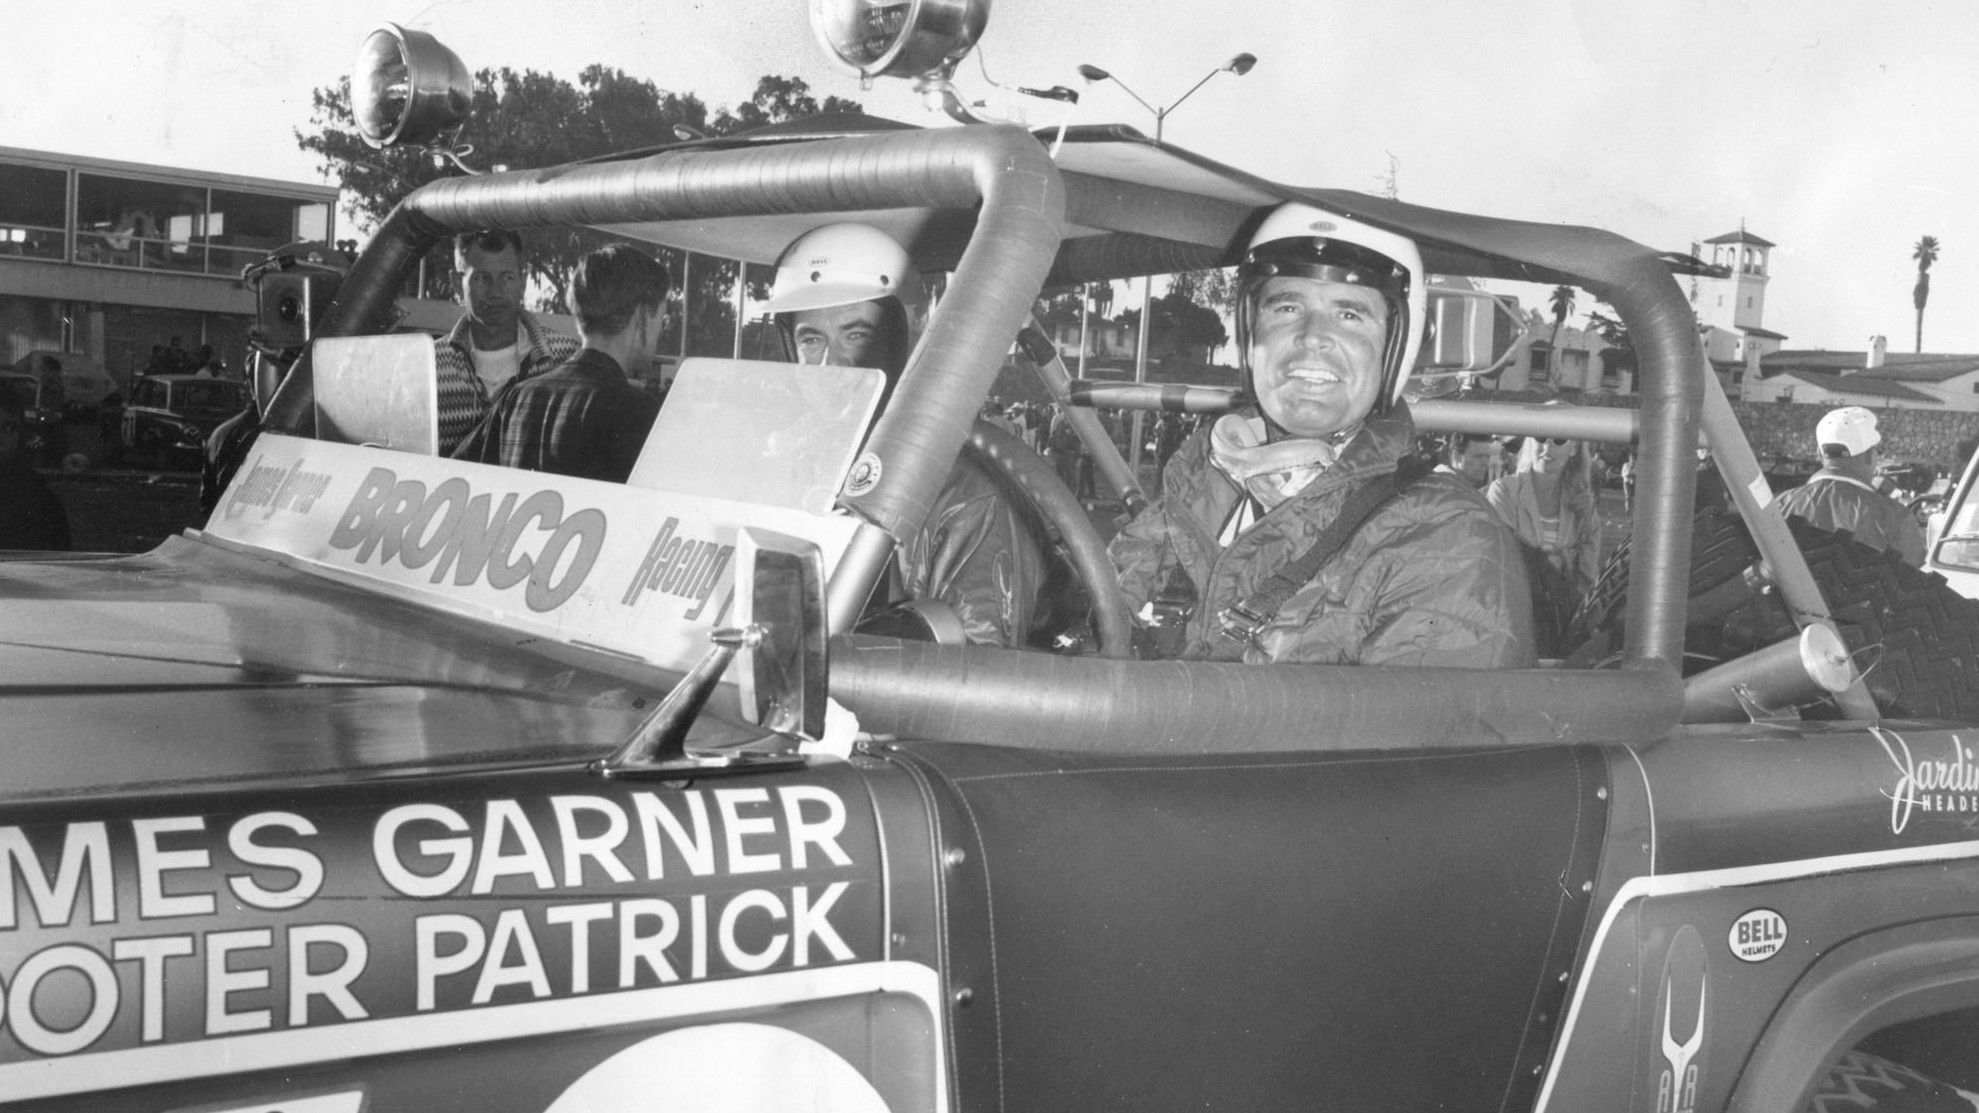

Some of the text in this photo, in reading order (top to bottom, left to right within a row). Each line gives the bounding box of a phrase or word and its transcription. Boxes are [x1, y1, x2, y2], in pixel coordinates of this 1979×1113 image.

[328, 466, 607, 613] BRONCO
[621, 516, 736, 621] Racing
[0, 785, 853, 929] MES GARNER
[0, 882, 857, 1057] OTER PATRICK
[1738, 917, 1782, 945] BELL
[1741, 944, 1776, 956] HELMETS
